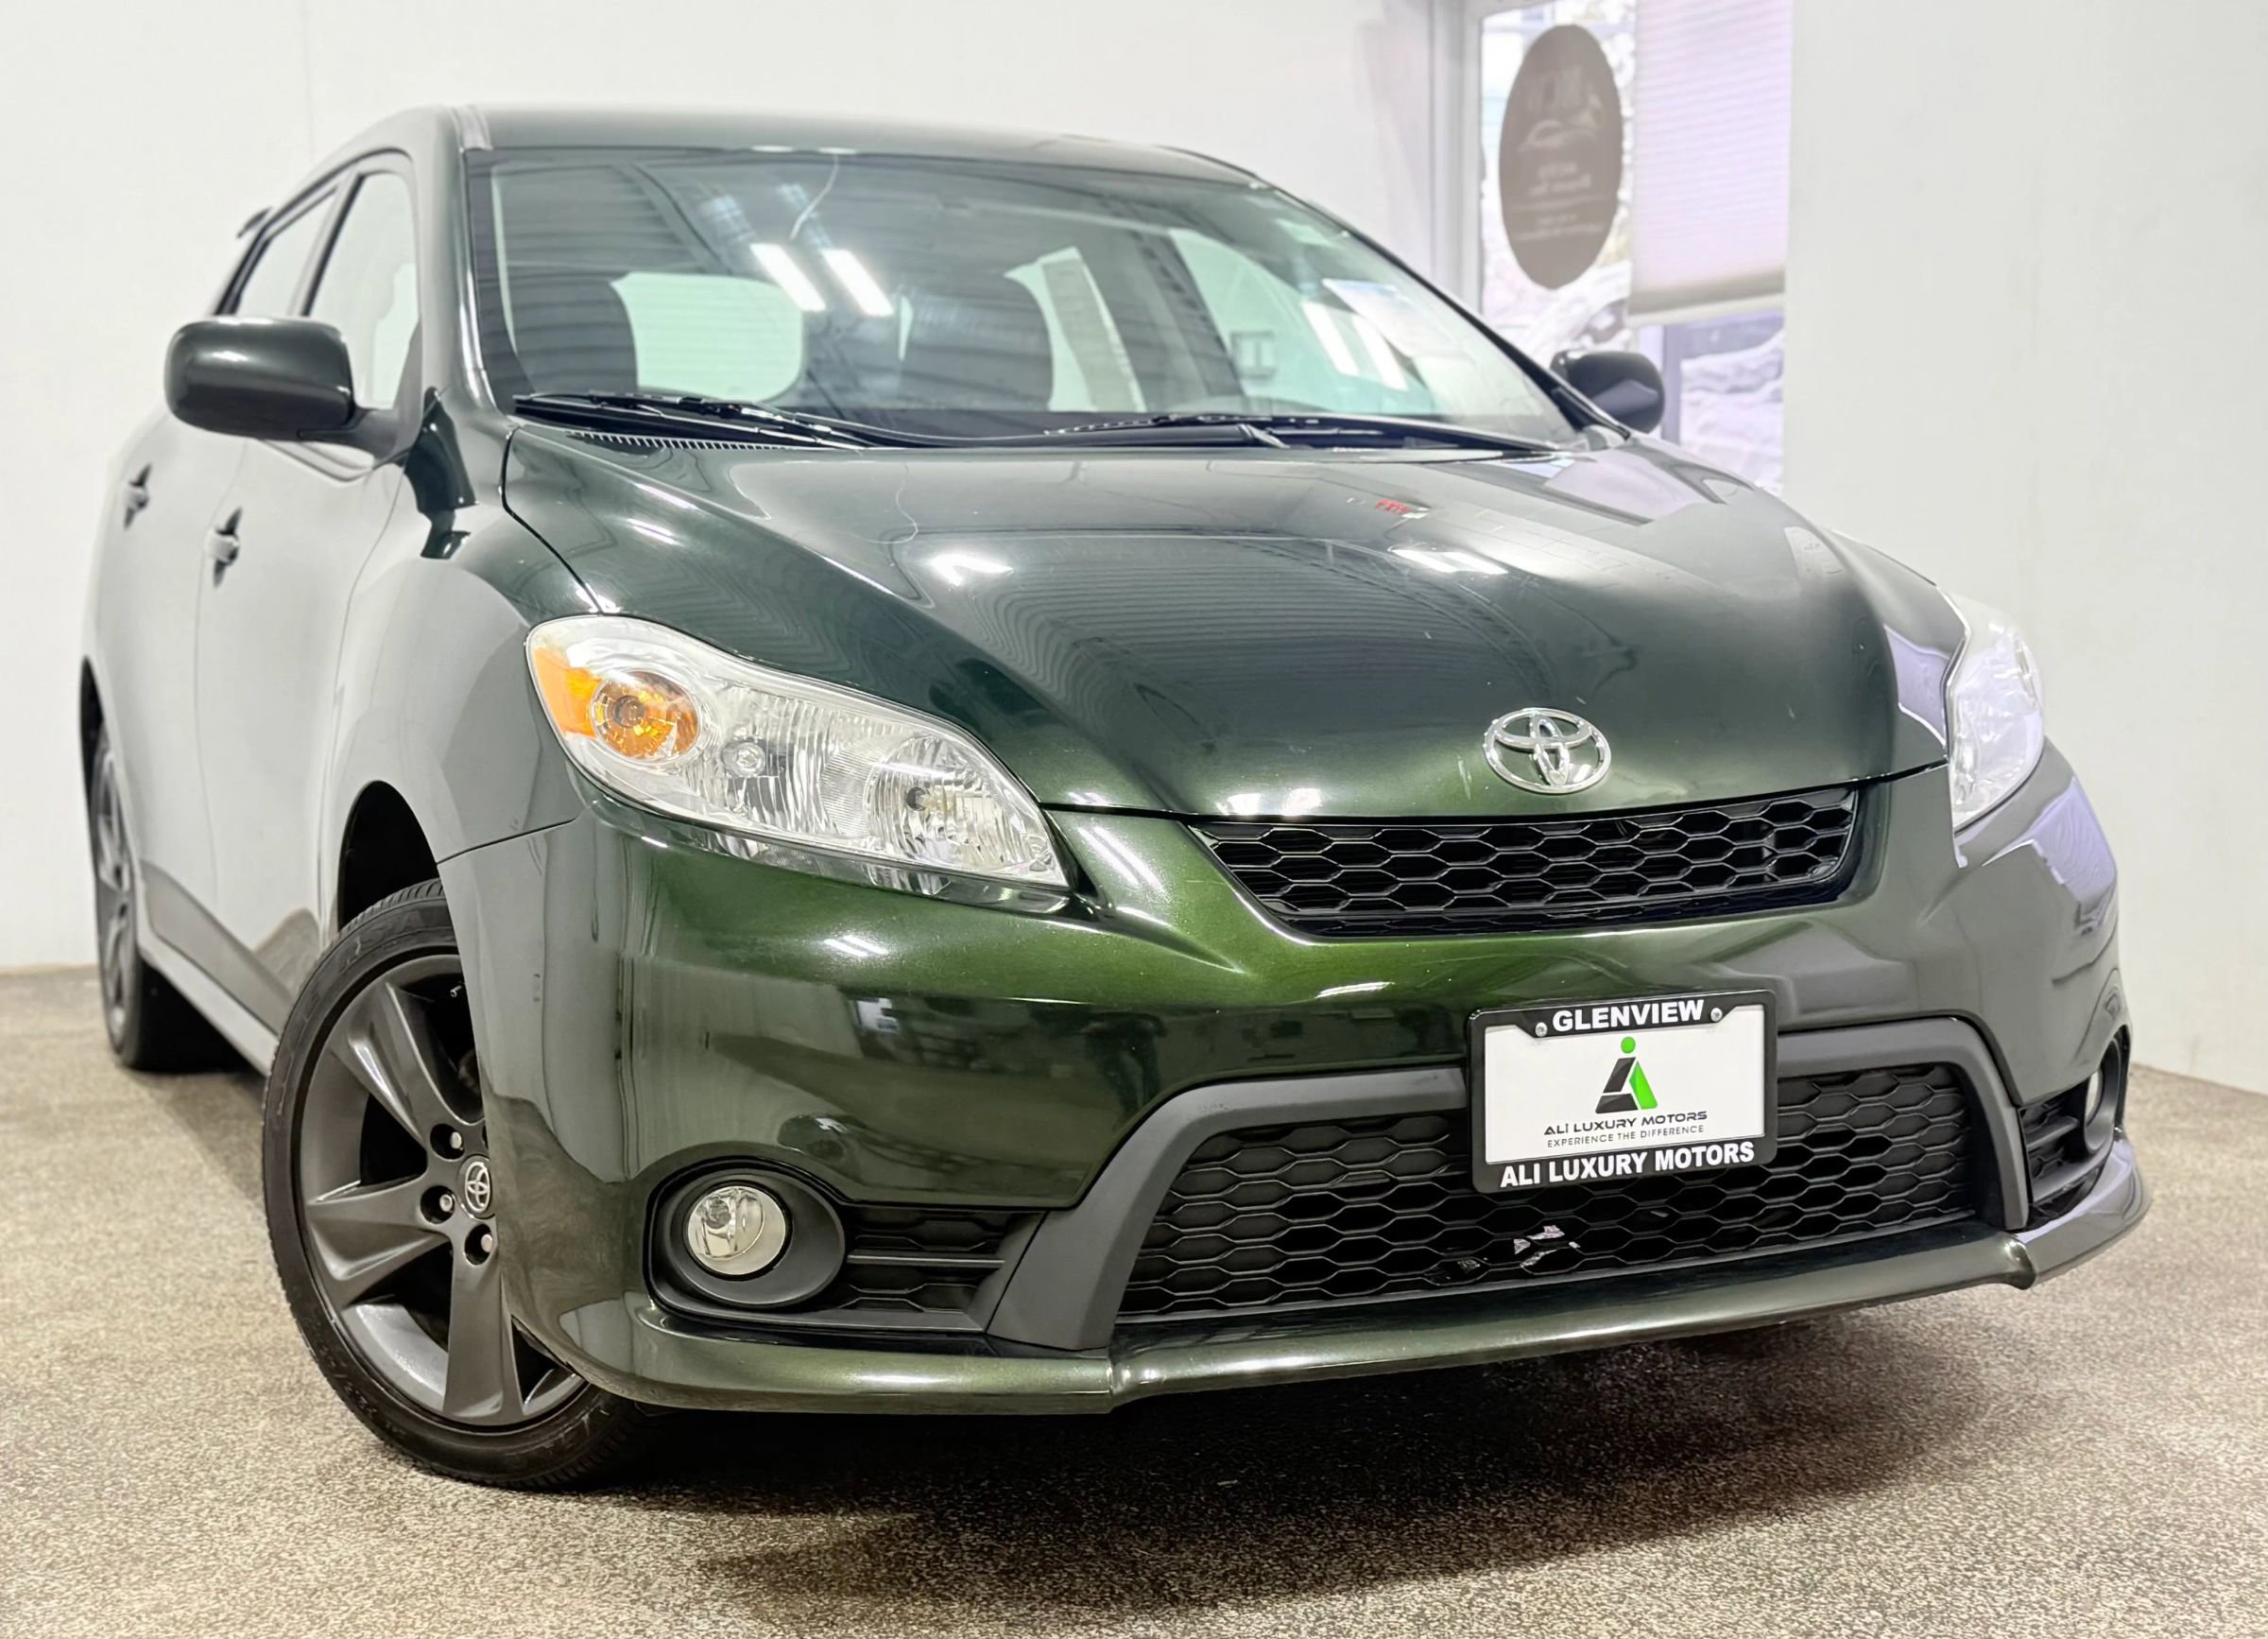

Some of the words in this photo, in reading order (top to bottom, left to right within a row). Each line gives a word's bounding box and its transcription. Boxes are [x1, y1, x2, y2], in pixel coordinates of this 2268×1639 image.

[1553, 1000, 1704, 1031] GLENVIEW
[1573, 1117, 1637, 1132] LUXURY
[1641, 1111, 1708, 1126] MOTORS
[1547, 1134, 1613, 1147] EXPERIENCE
[1617, 1131, 1636, 1140] THE
[1641, 1125, 1704, 1138] DIFFERENCE
[1501, 1165, 1540, 1188] ALI
[1549, 1152, 1648, 1182] LUXURY
[1655, 1142, 1755, 1172] MOTORS
